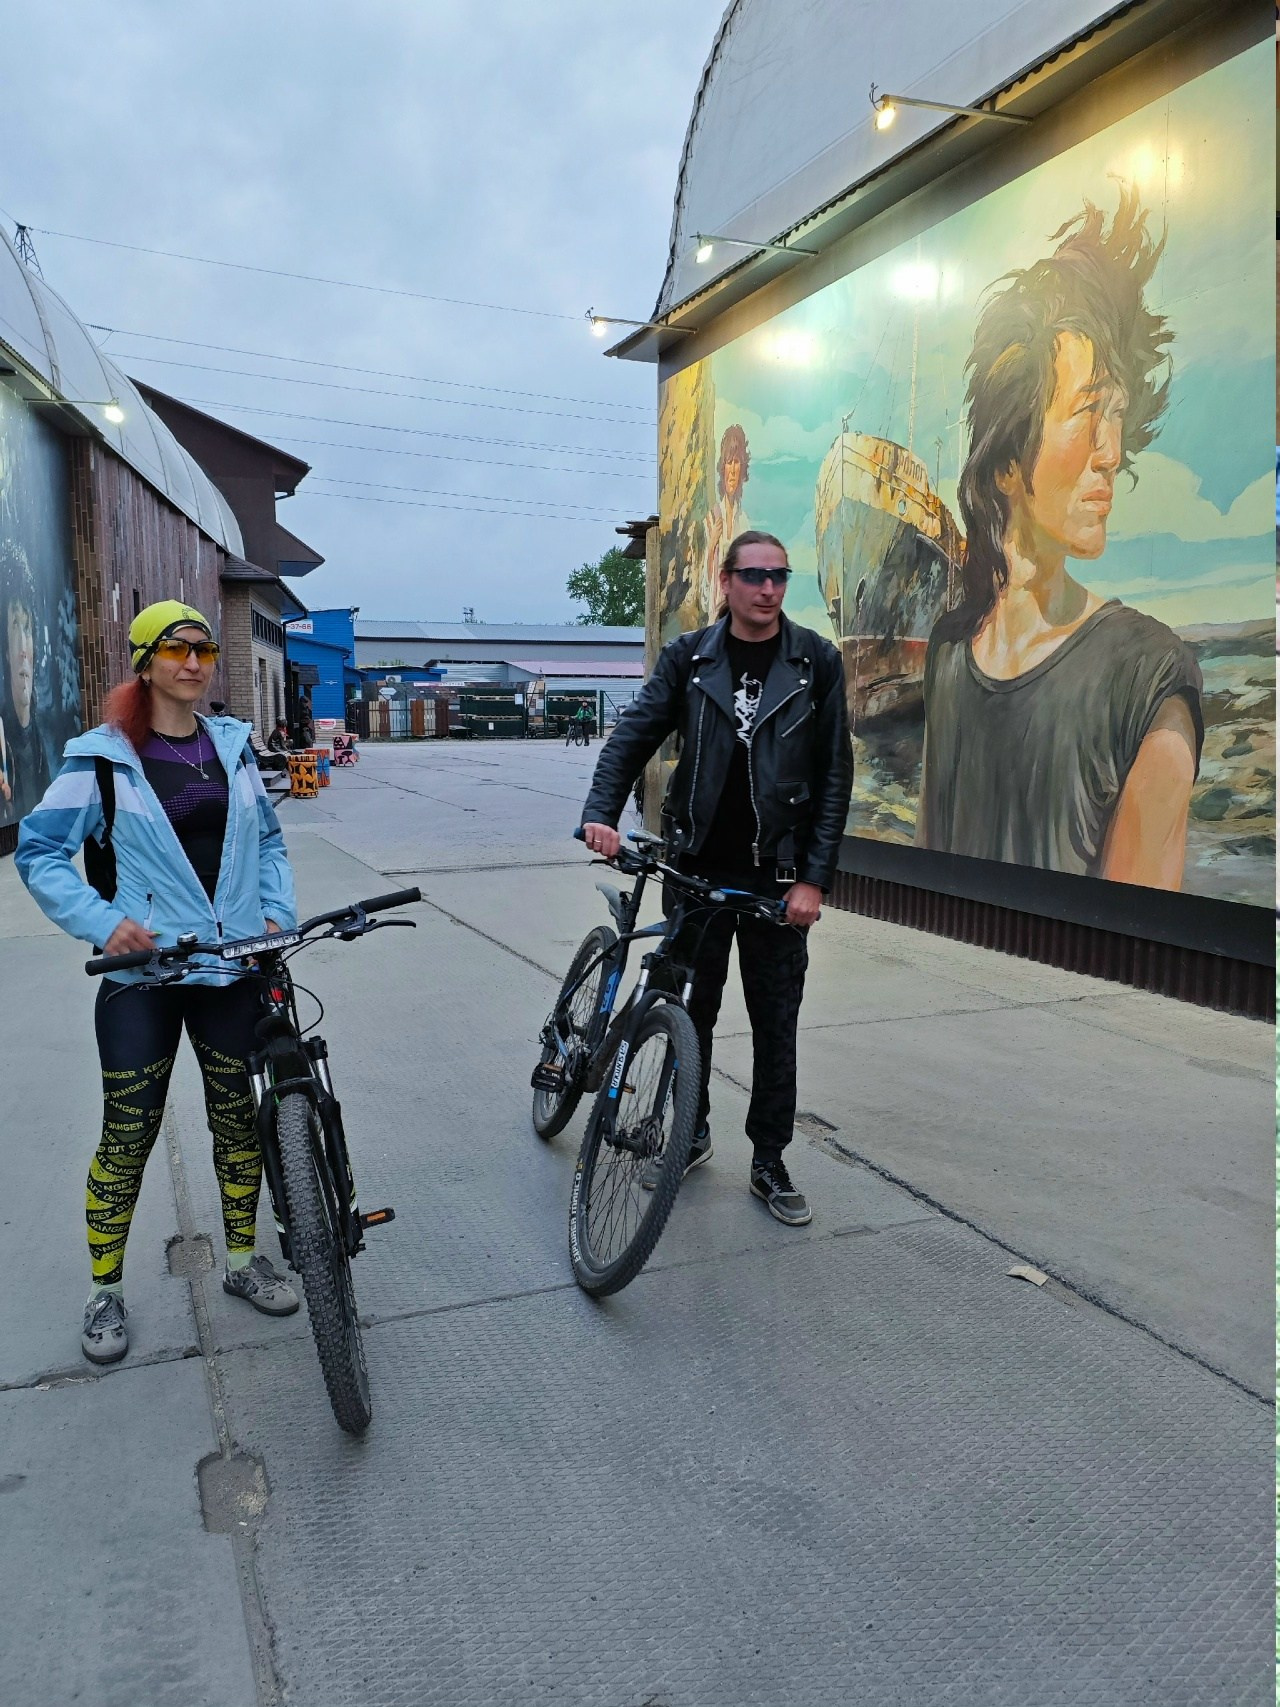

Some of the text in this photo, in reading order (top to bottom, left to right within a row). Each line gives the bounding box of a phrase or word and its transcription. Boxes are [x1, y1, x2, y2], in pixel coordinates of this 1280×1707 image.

[111, 1080, 150, 1099] DANGER
[108, 1121, 144, 1132] DANGER
[107, 1145, 126, 1154] OUT
